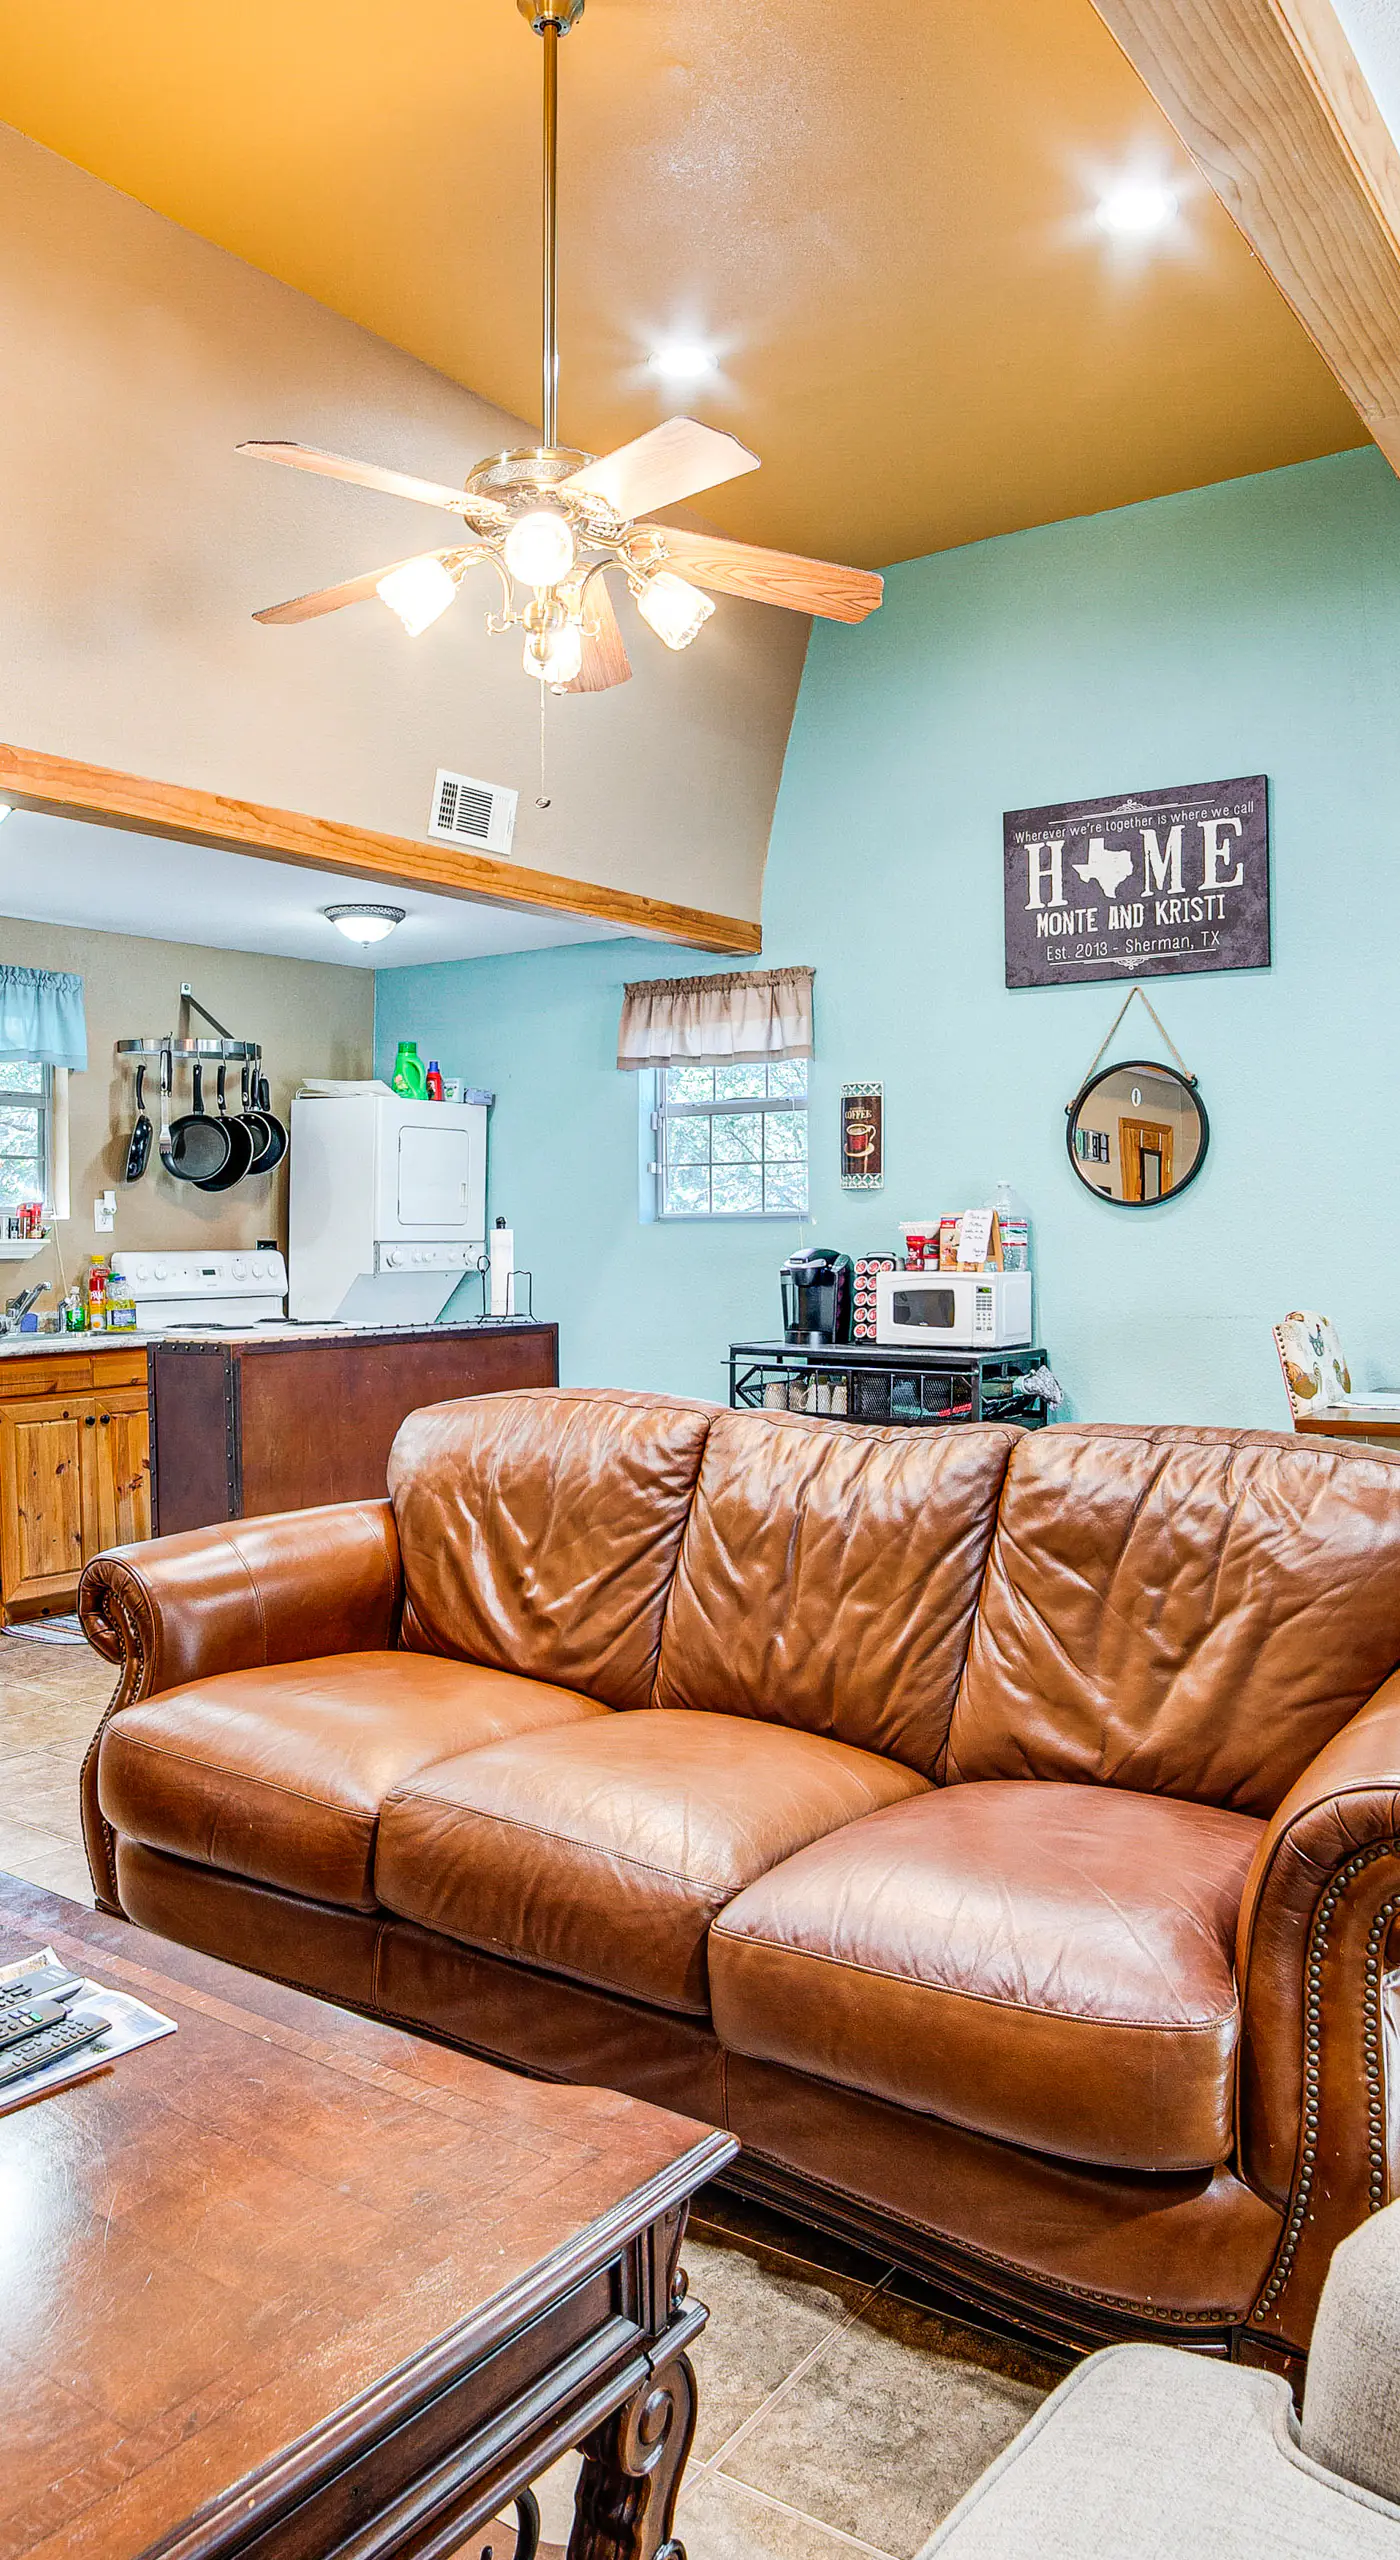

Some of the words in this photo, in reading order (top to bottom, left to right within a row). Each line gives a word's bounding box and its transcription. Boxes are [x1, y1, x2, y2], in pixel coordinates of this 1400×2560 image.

[1014, 827, 1067, 844] Wherever
[1069, 822, 1102, 837] we're
[1105, 816, 1153, 834] together
[1157, 813, 1168, 826] is
[1170, 807, 1208, 823] where
[1211, 804, 1231, 818] we
[1233, 800, 1255, 815] call
[1036, 907, 1099, 938] MONTE
[1108, 902, 1145, 931] AND
[1155, 894, 1226, 926] KRISTI
[1047, 946, 1071, 961] Est.
[1075, 941, 1108, 957] 2013
[1125, 936, 1195, 954] Sherman,
[1201, 930, 1221, 946] TX
